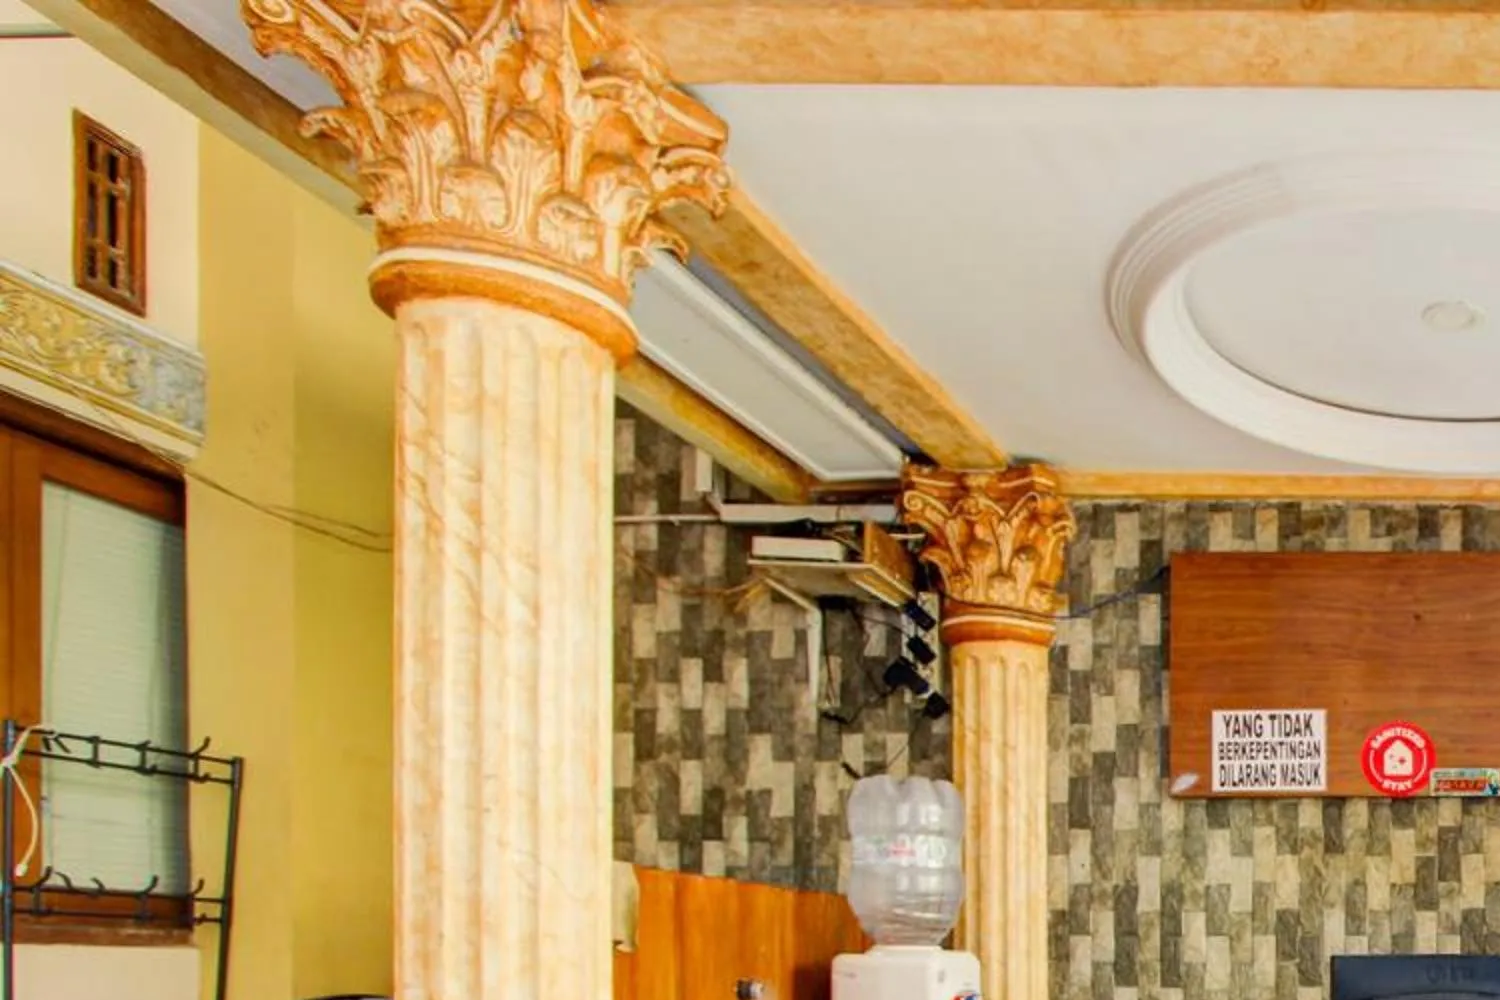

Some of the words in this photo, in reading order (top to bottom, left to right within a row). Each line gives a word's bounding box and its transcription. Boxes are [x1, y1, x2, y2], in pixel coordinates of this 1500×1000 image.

[1223, 713, 1263, 738] YANG
[1268, 713, 1313, 738] TIDAK
[1217, 740, 1321, 761] BERKEPENTINGAN
[1218, 763, 1277, 787] DILARANG
[1280, 763, 1321, 787] MASUK
